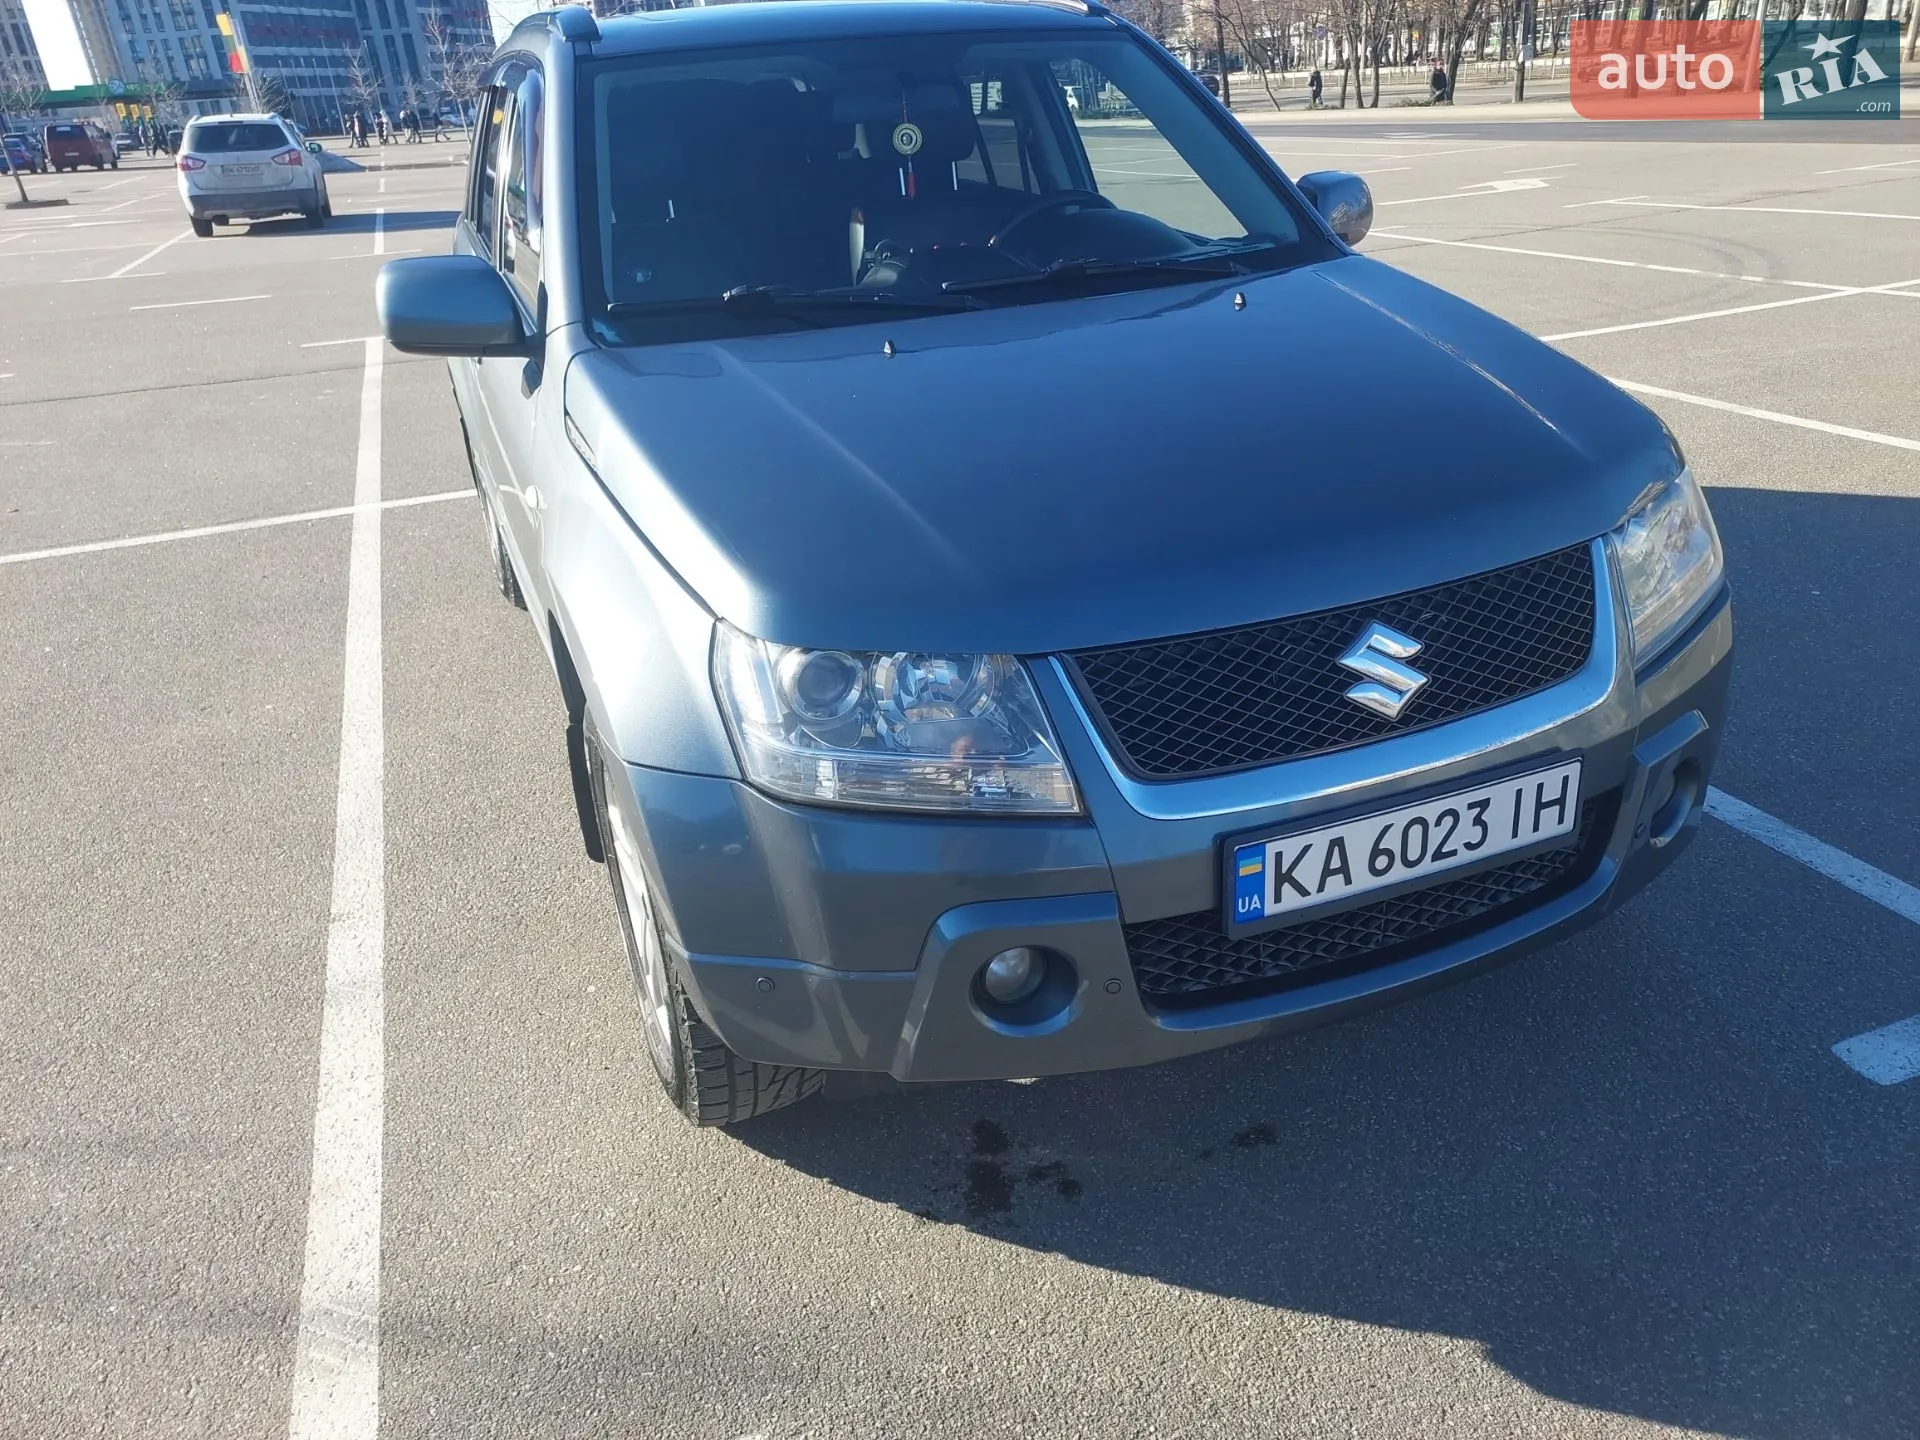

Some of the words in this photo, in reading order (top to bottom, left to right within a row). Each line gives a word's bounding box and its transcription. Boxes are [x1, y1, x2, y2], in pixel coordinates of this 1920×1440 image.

[1273, 836, 1353, 904] KA
[1367, 797, 1491, 877] 6023
[1510, 774, 1570, 839] IH
[1238, 893, 1262, 913] UA
